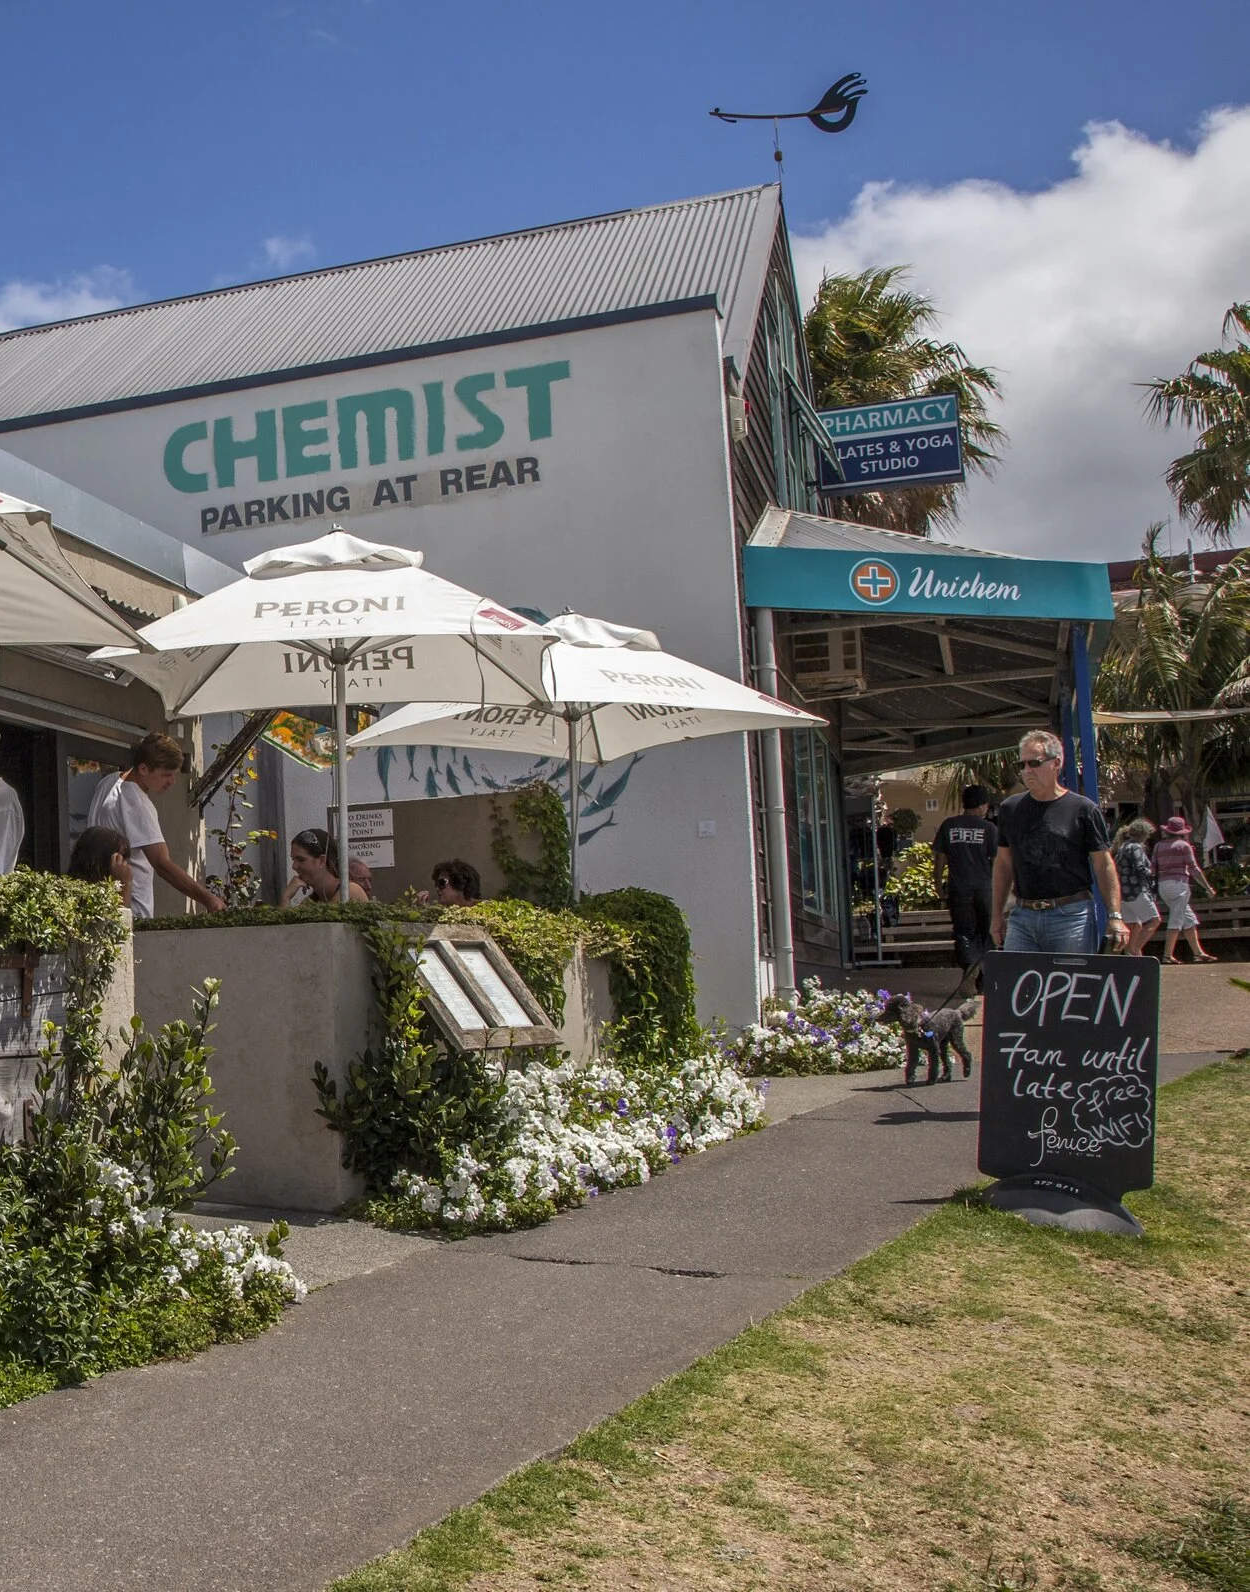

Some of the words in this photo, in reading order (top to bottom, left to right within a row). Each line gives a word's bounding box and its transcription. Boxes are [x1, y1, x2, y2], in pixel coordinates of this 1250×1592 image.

[162, 360, 571, 494] CHEMIST
[822, 402, 951, 433] PHARMACY
[837, 442, 885, 460] LATES
[889, 440, 901, 454] &
[904, 434, 954, 452] YOGA
[860, 455, 920, 475] STUDIO
[200, 486, 350, 534] PARKING
[372, 474, 418, 507] AT
[439, 456, 541, 497] REAR
[908, 566, 1021, 601] Unichem
[253, 596, 405, 619] PERONI
[289, 616, 365, 628] ITALY
[597, 668, 707, 690] PERONI
[352, 828, 374, 836] POINT
[949, 830, 985, 841] FIRE
[1011, 969, 1141, 1027] OPEN
[998, 1032, 1066, 1069] 7am
[1081, 1036, 1150, 1073] until
[1013, 1069, 1076, 1099] late
[1027, 1106, 1103, 1167] fenice
[1091, 1112, 1145, 1140] WIFI
